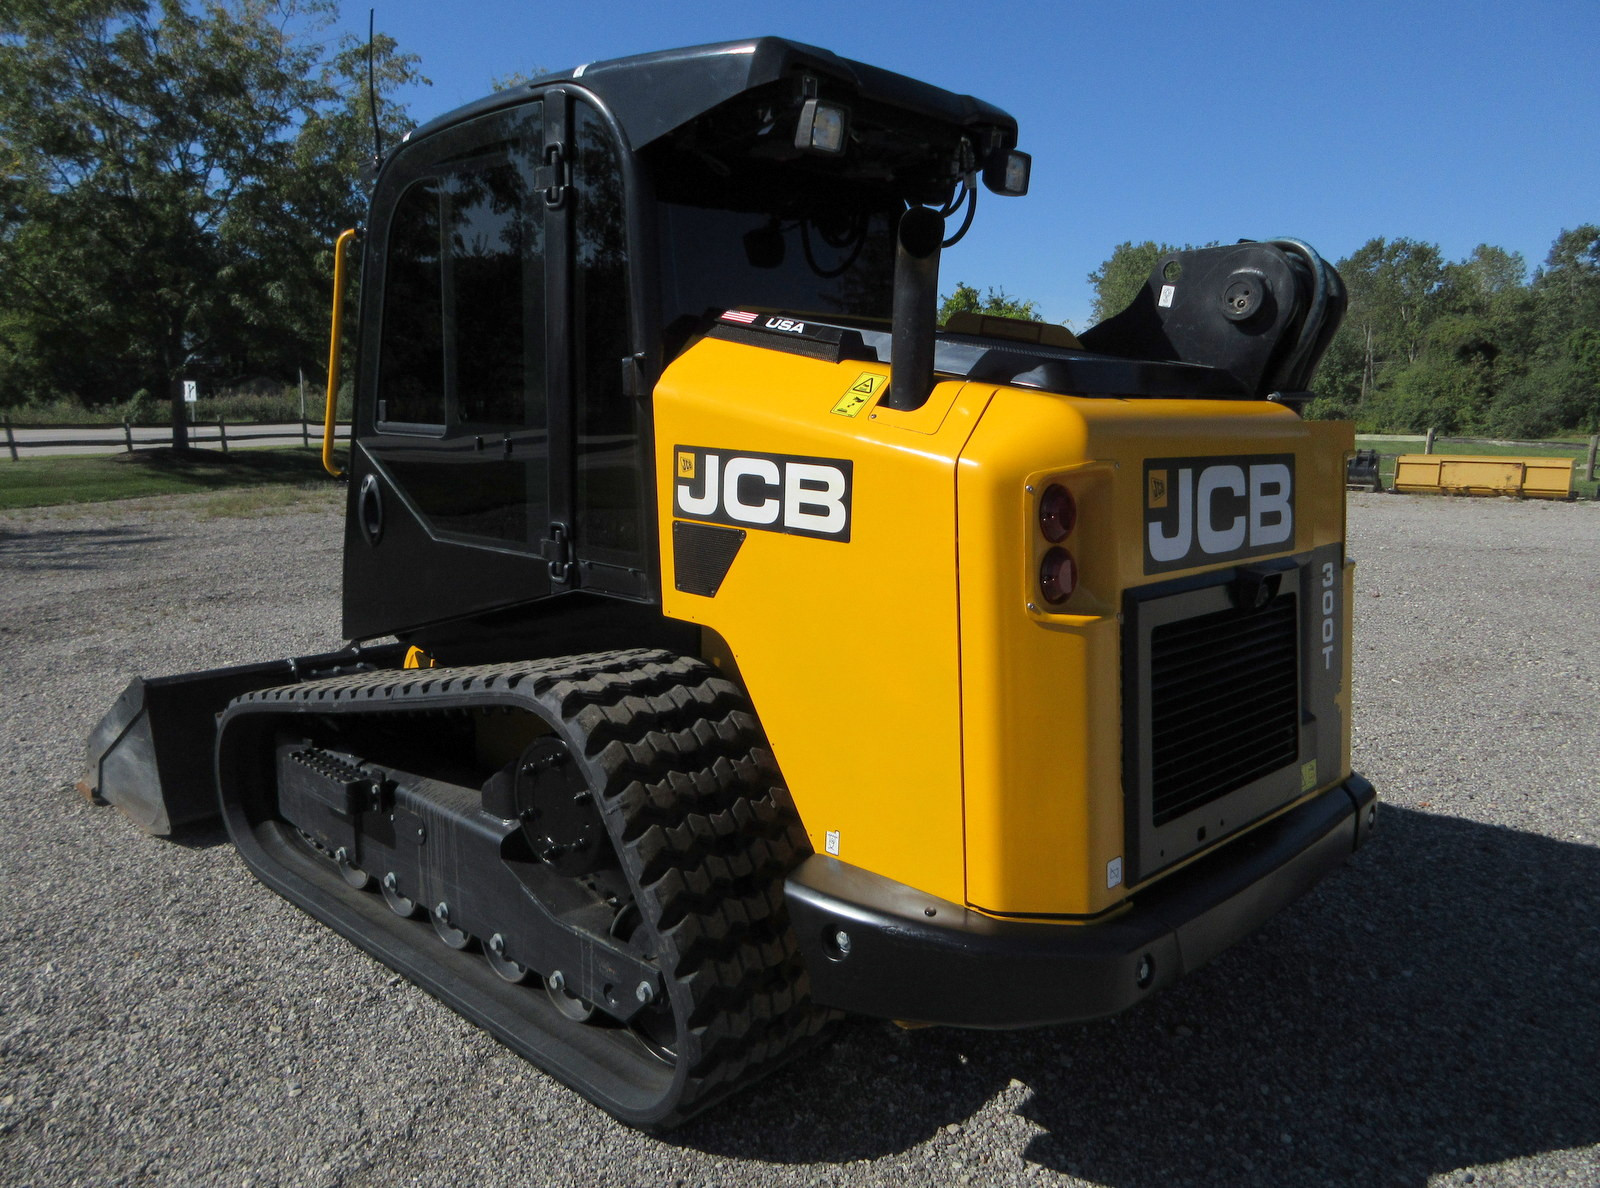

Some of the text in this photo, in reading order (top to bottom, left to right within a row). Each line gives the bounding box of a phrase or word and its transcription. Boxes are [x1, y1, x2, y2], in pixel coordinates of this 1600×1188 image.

[765, 317, 804, 334] USA
[677, 454, 846, 533] JCB
[680, 458, 693, 471] JCB
[1148, 464, 1292, 562] JCB
[1321, 562, 1334, 670] 300T
